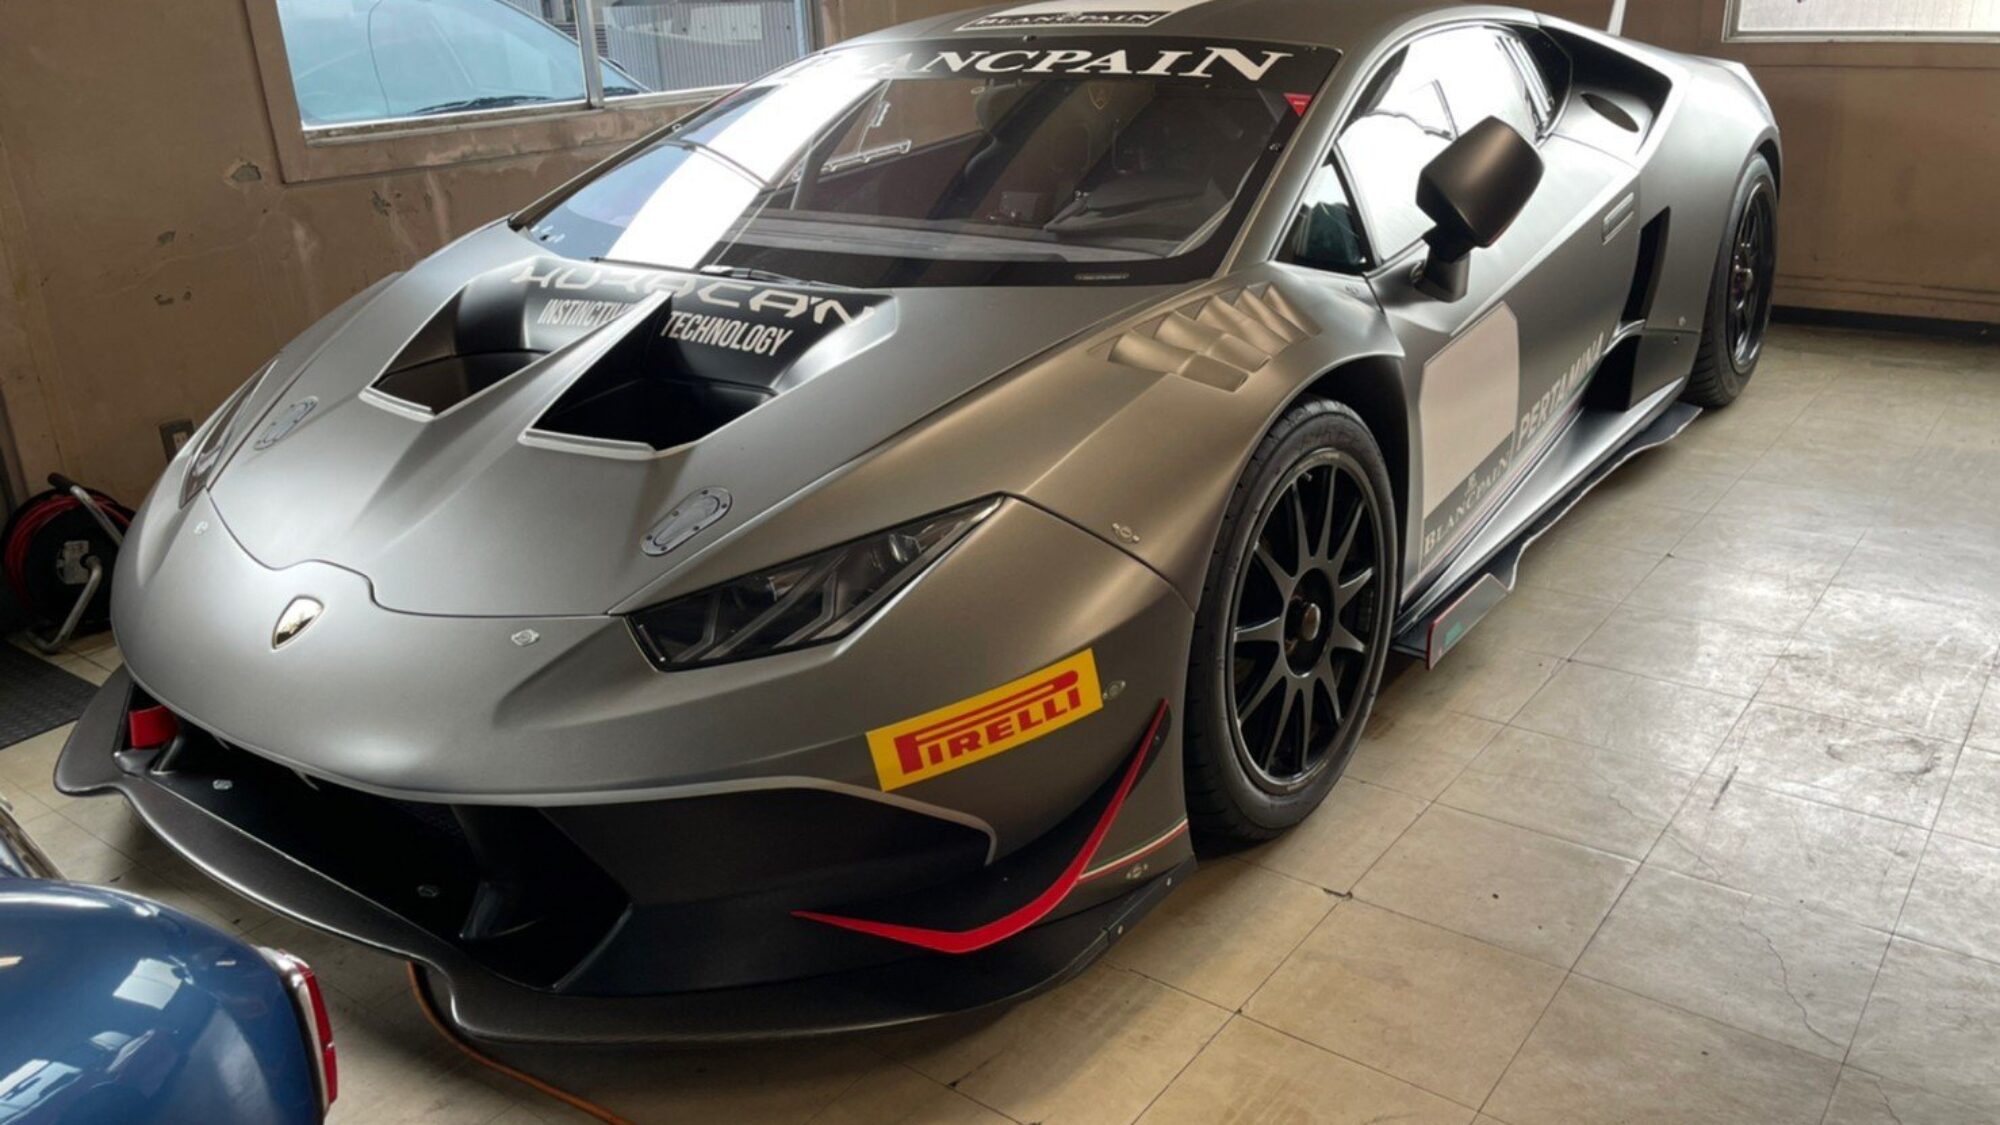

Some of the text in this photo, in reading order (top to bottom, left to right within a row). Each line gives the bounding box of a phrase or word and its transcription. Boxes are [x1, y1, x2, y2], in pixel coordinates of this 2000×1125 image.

[864, 46, 1293, 82] ANCPAIN
[537, 299, 796, 358] INSTINCTIV TECHNOLOGY
[893, 669, 1082, 775] PIRELLI
